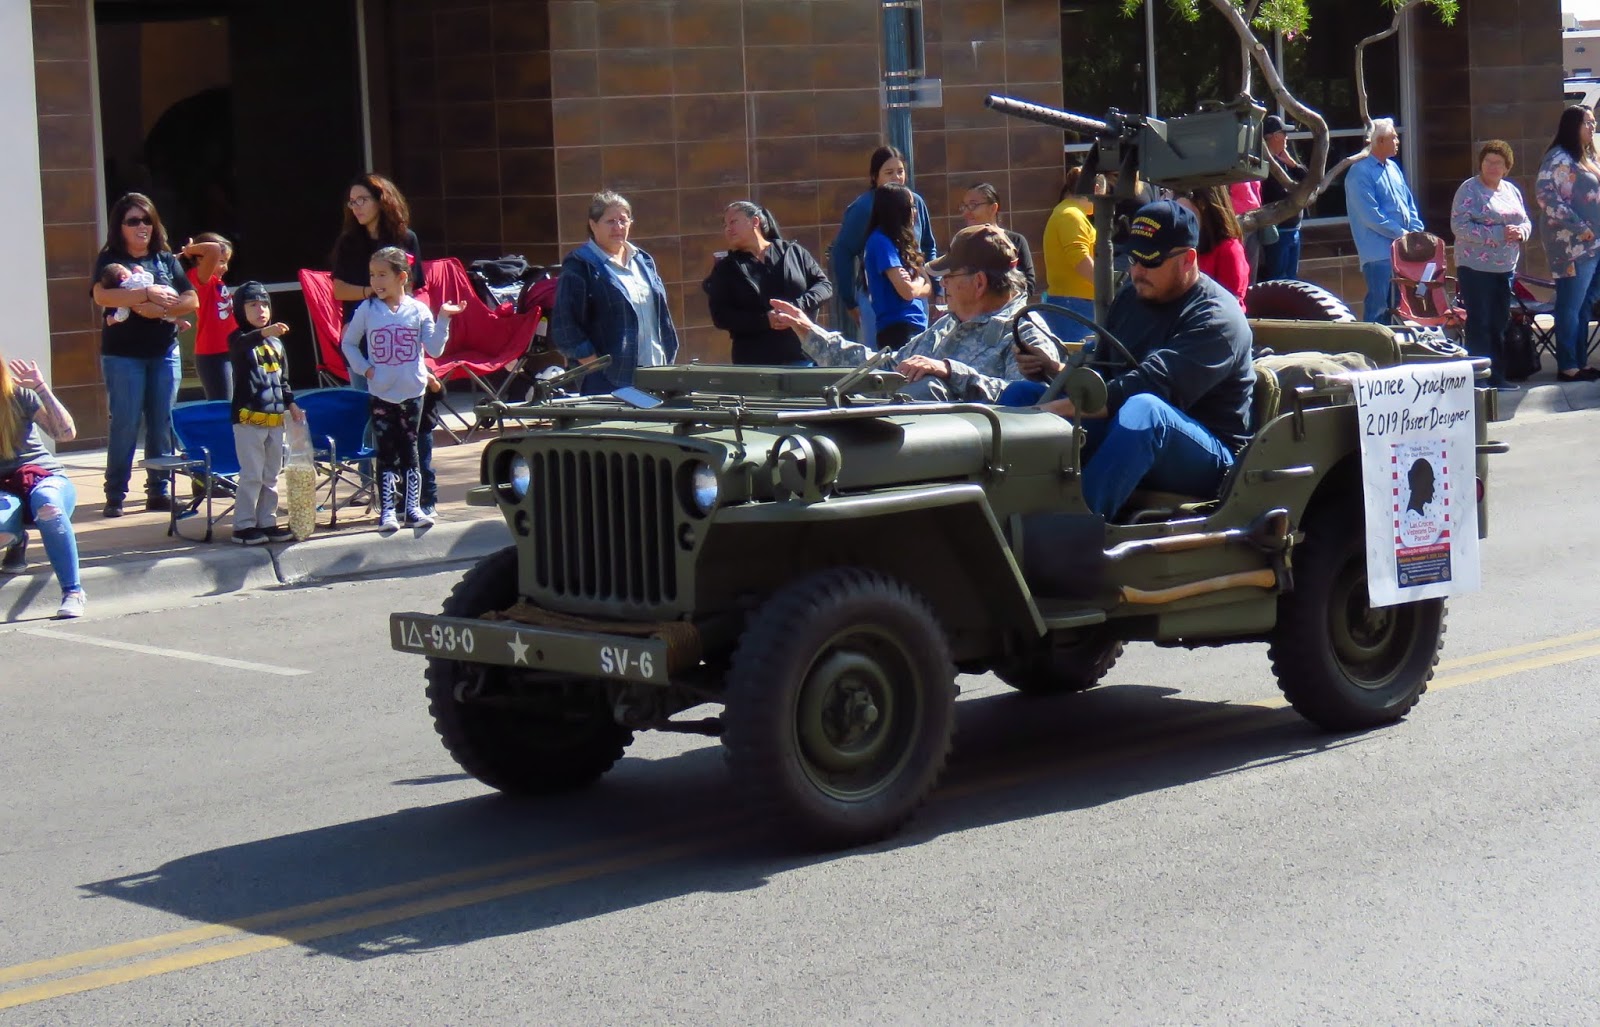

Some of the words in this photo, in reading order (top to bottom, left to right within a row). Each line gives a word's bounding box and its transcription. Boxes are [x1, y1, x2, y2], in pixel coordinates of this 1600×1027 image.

[370, 327, 419, 364] 95
[1411, 371, 1467, 403] Stockman
[1367, 413, 1398, 436] 2019
[1400, 408, 1429, 435] Poster
[1429, 406, 1470, 431] Designer
[1406, 528, 1427, 536] Veterans
[1428, 526, 1437, 534] Day
[600, 646, 653, 678] SV-6
